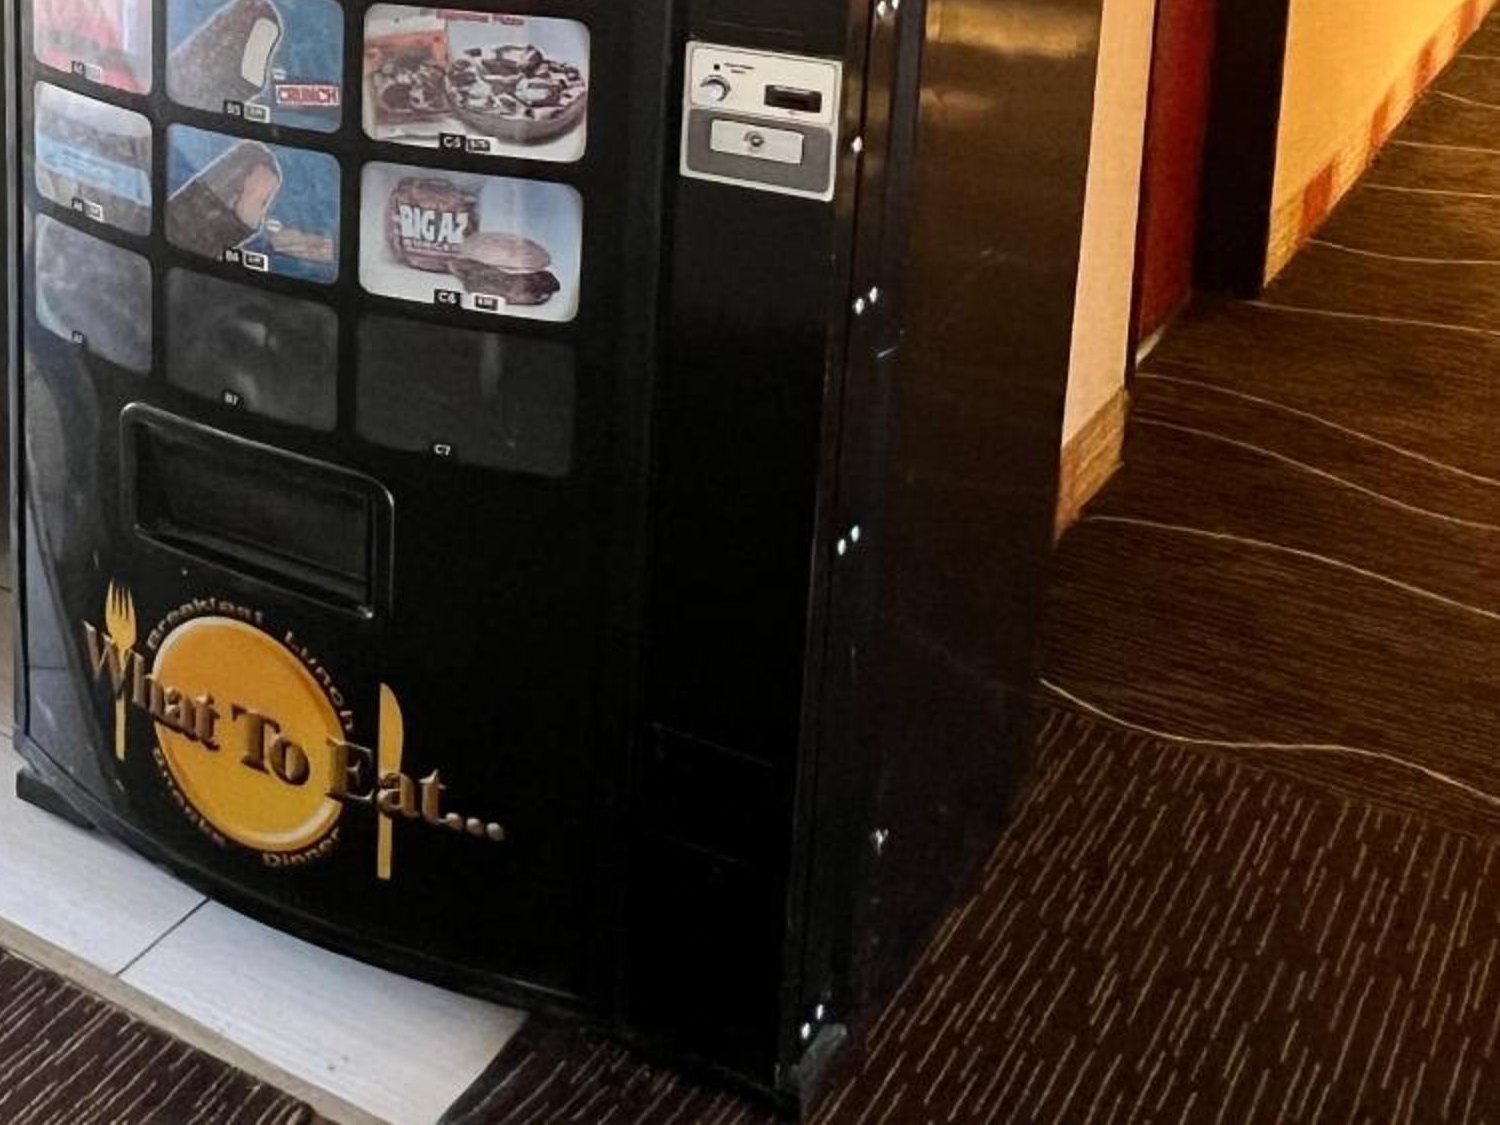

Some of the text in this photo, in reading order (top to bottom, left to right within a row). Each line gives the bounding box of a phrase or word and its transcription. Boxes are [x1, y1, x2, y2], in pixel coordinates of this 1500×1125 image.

[399, 204, 435, 242] BIG
[434, 444, 451, 456] C7
[284, 631, 353, 731] Lunch
[83, 619, 220, 752] What
[232, 703, 311, 787] To
[262, 828, 341, 868] Dinner
